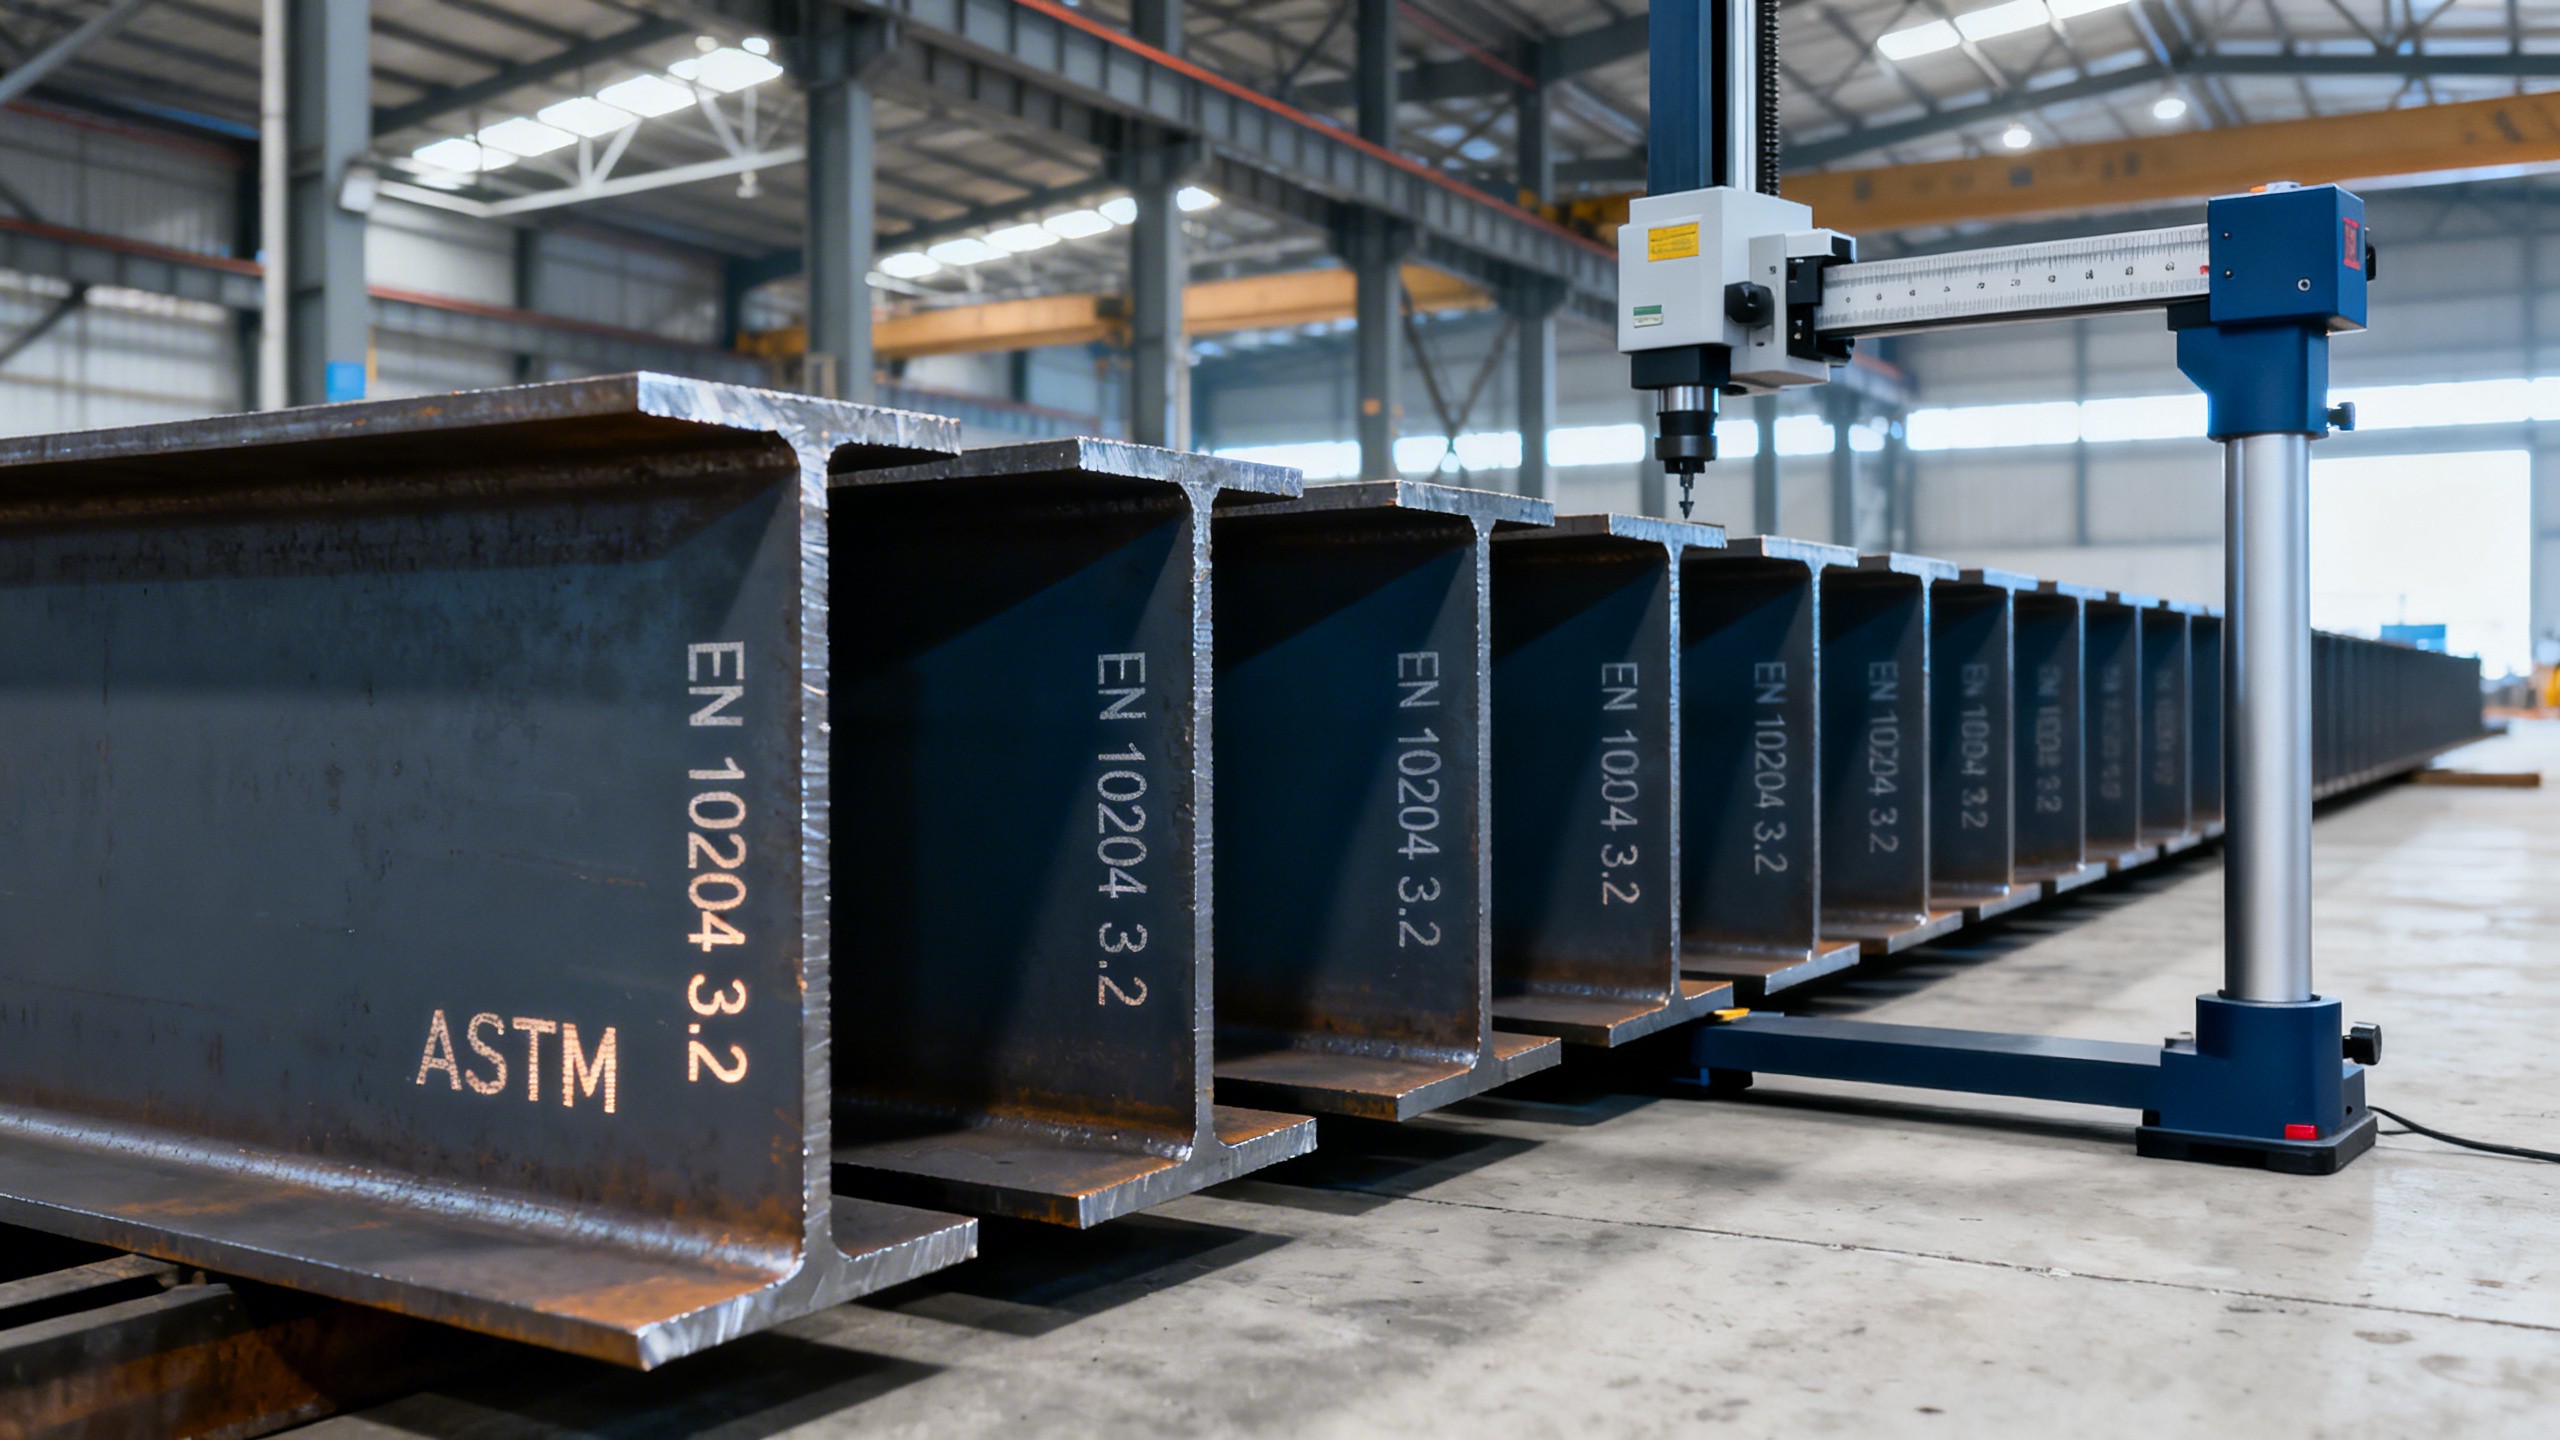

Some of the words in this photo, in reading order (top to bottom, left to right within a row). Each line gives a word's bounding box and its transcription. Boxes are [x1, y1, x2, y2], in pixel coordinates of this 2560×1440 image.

[687, 640, 746, 728] EN
[1098, 652, 1146, 720] EN
[1398, 652, 1440, 708] EN
[1601, 662, 1639, 711] EN
[1754, 661, 1788, 705] EN
[1398, 727, 1442, 860] 10204
[1754, 714, 1788, 809] 10204
[687, 757, 748, 953] 10204
[1097, 742, 1148, 899] 10204
[1753, 821, 1789, 875] 3.2
[1398, 876, 1441, 948] 3.2
[1600, 844, 1641, 906] 3.2
[1098, 922, 1148, 1006] 3.2
[415, 1009, 618, 1114] ASTM
[687, 973, 749, 1083] 3.2
